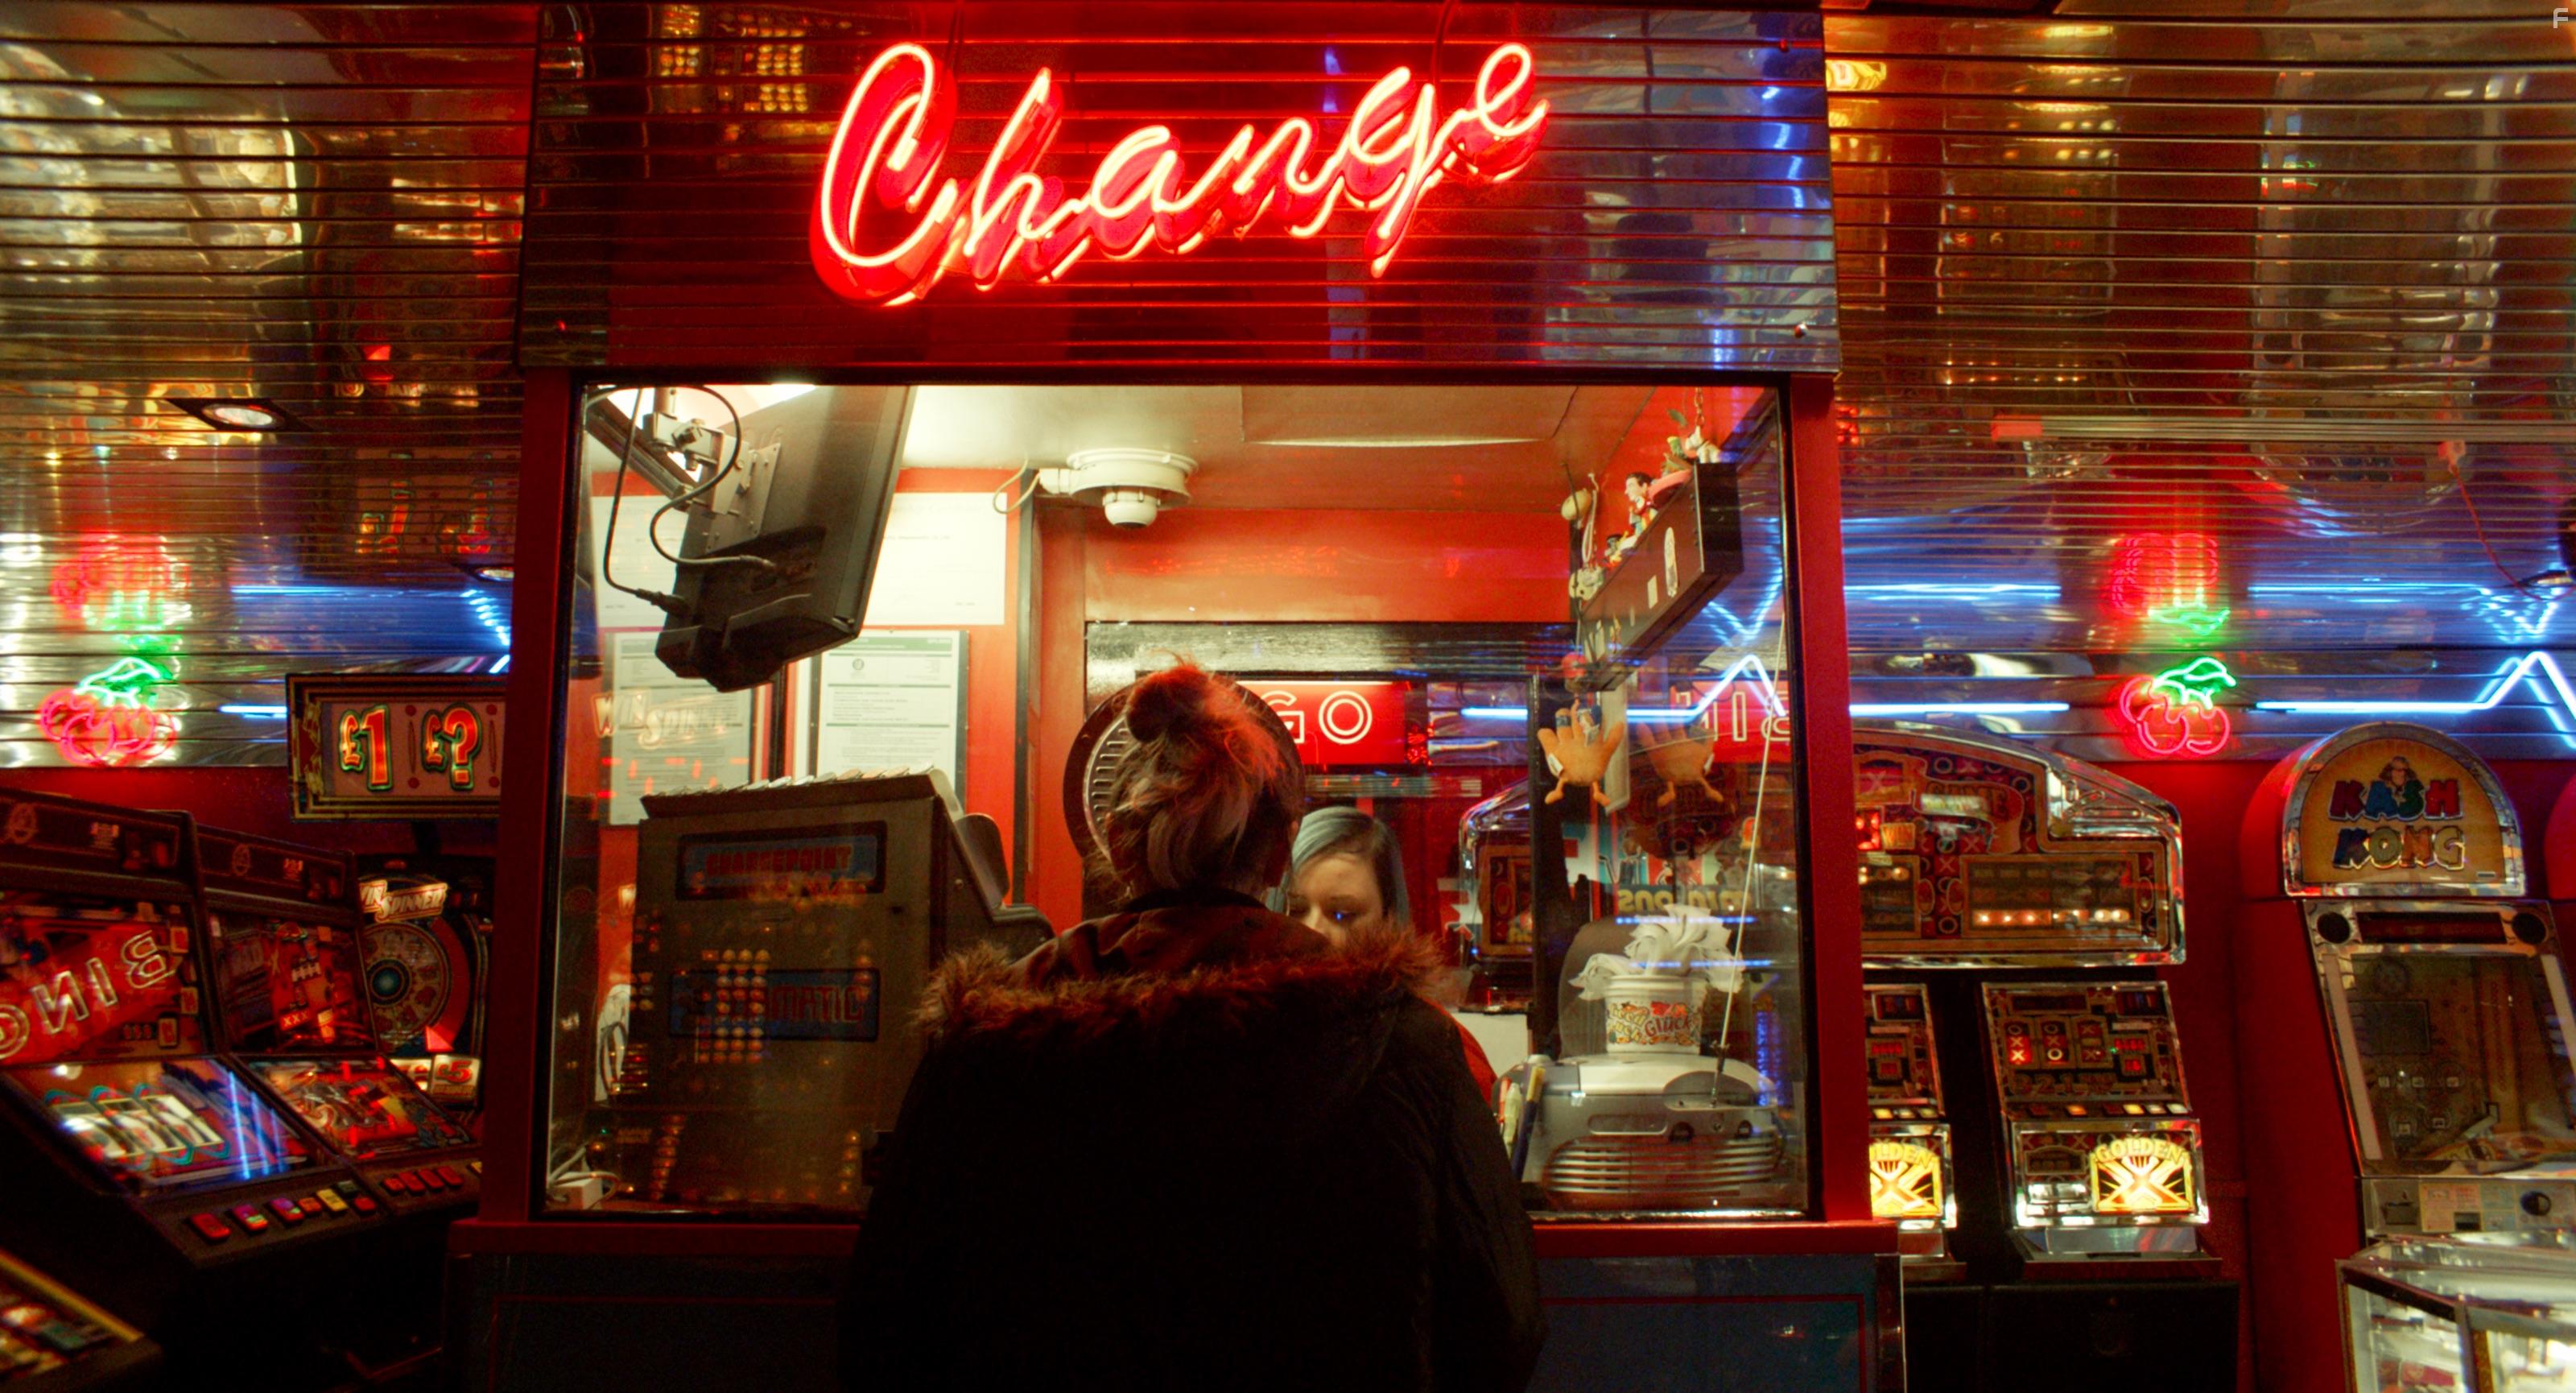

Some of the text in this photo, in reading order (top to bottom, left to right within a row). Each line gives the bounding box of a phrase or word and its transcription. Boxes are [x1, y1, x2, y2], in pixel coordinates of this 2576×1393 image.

[818, 42, 1550, 278] Change
[340, 704, 392, 791] £1
[2329, 779, 2462, 821] KASH
[2332, 825, 2465, 871] KONG
[2095, 1137, 2185, 1165] GOLDEN
